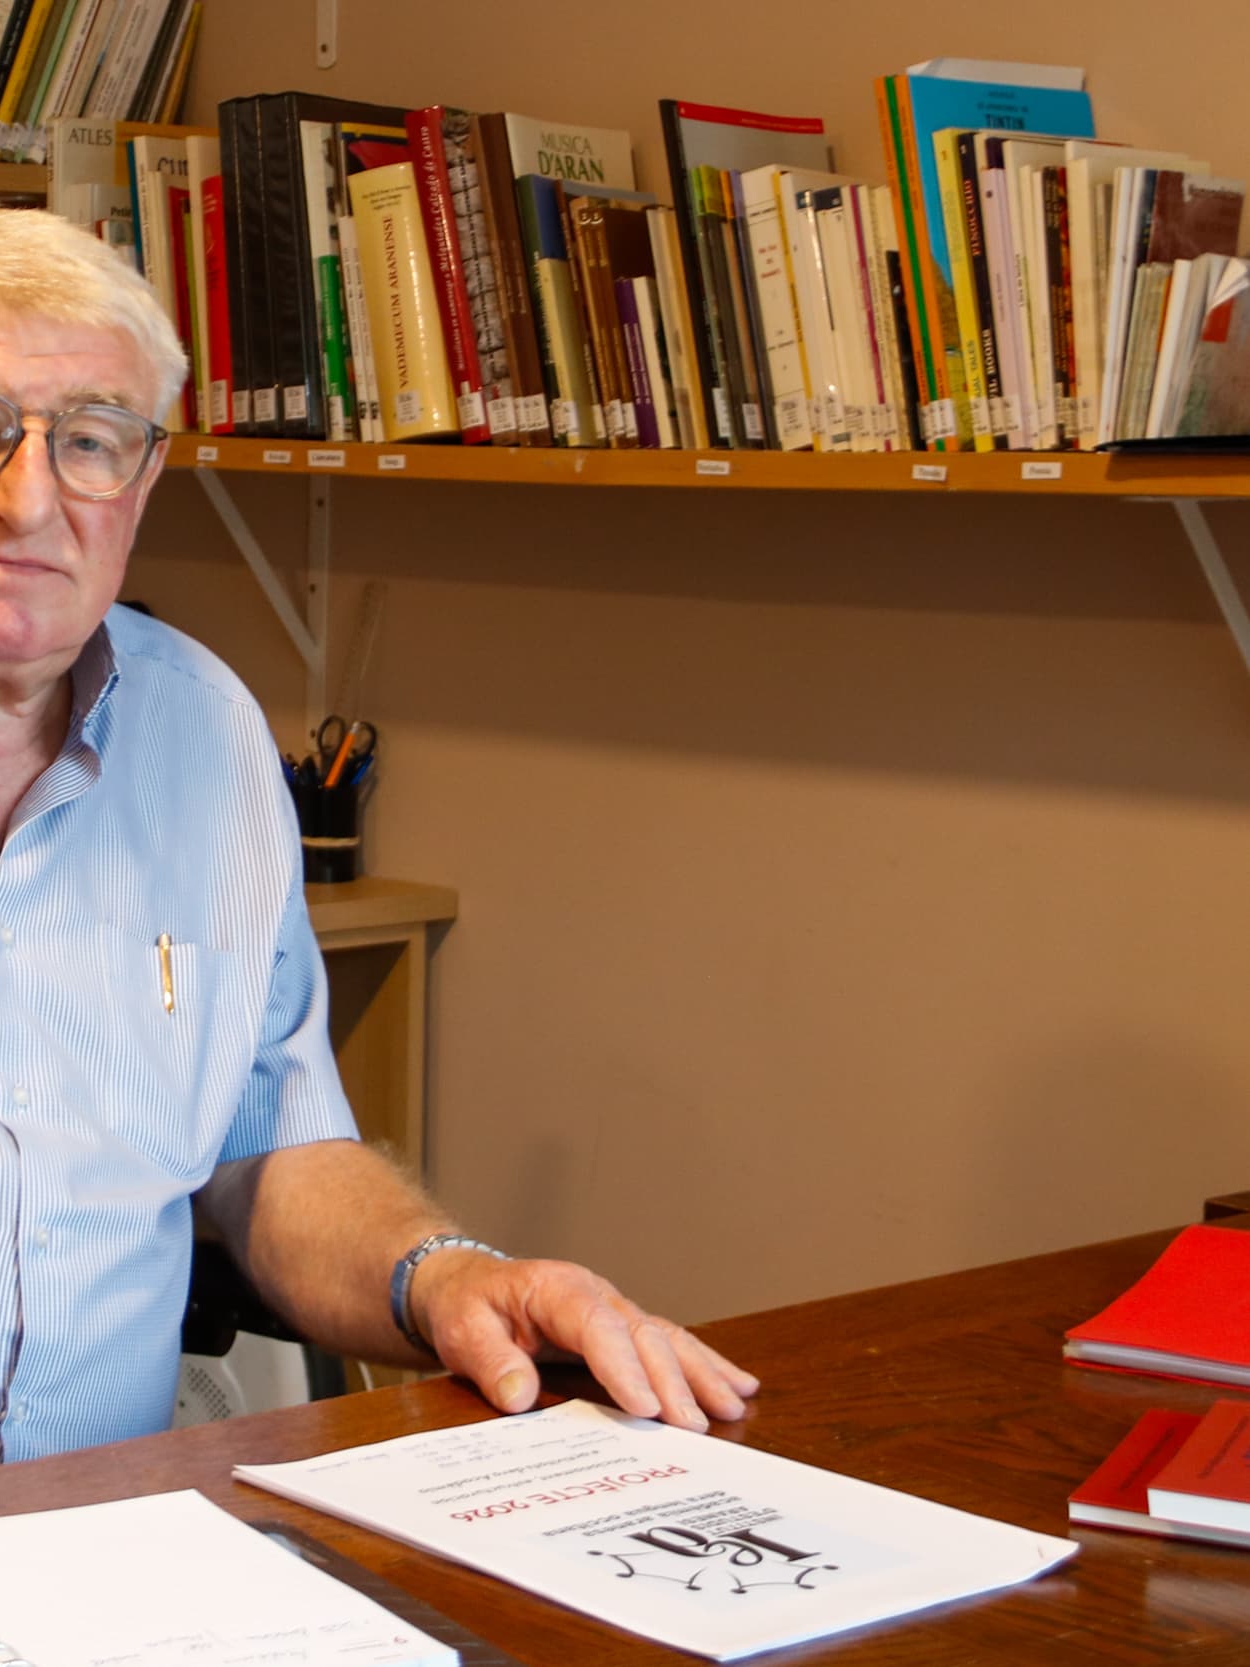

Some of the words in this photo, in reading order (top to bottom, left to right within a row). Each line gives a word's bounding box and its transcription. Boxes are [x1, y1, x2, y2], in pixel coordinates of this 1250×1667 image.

[383, 216, 399, 288] ARANENSE
[390, 293, 409, 388] VADEMECUM
[449, 1500, 530, 1523] 2026
